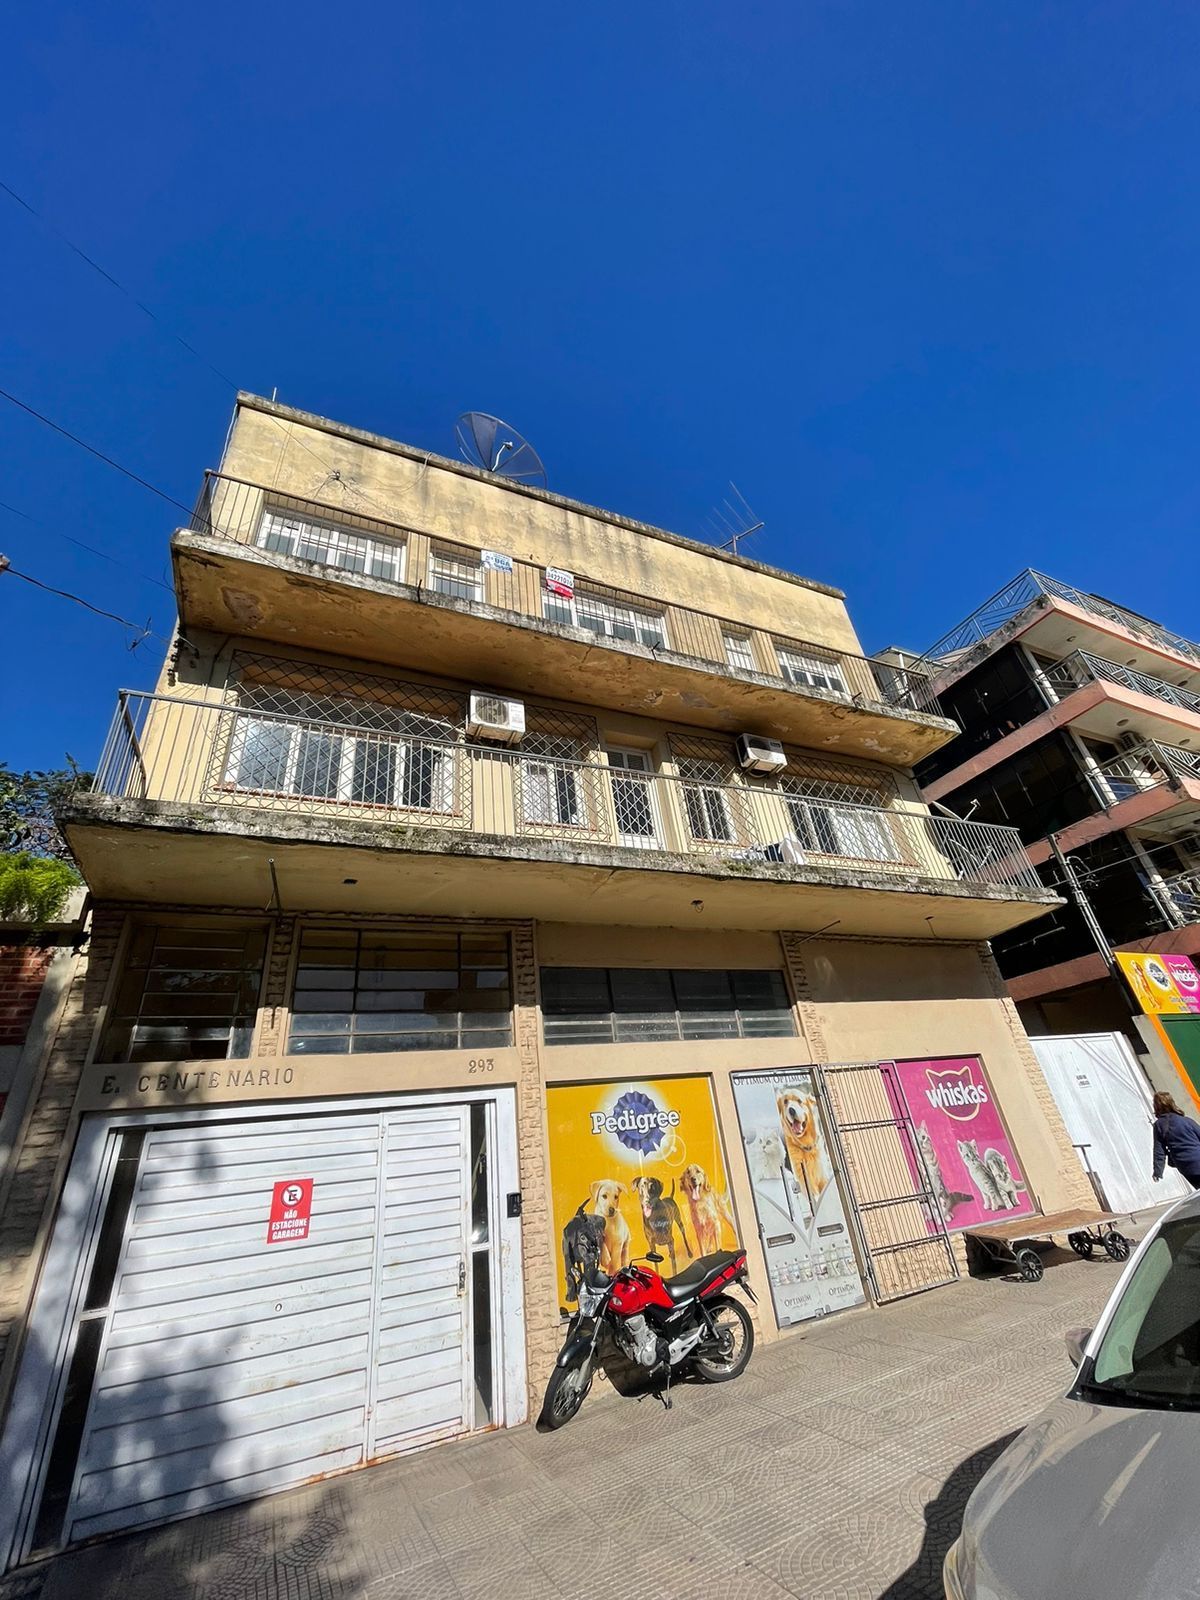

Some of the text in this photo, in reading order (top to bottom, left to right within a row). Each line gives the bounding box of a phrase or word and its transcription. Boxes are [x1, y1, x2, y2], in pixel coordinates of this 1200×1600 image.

[469, 1058, 494, 1074] 293
[101, 1068, 294, 1094] E. CENTENARIO
[925, 1080, 988, 1109] whiskas
[590, 1109, 680, 1135] Pedigree
[284, 1209, 298, 1219] NÃO
[272, 1218, 308, 1230] ESTACIONE
[272, 1228, 305, 1240] GARAGEM
[828, 1283, 856, 1296] OPTIMUM
[784, 1293, 812, 1307] OPTIMUM
